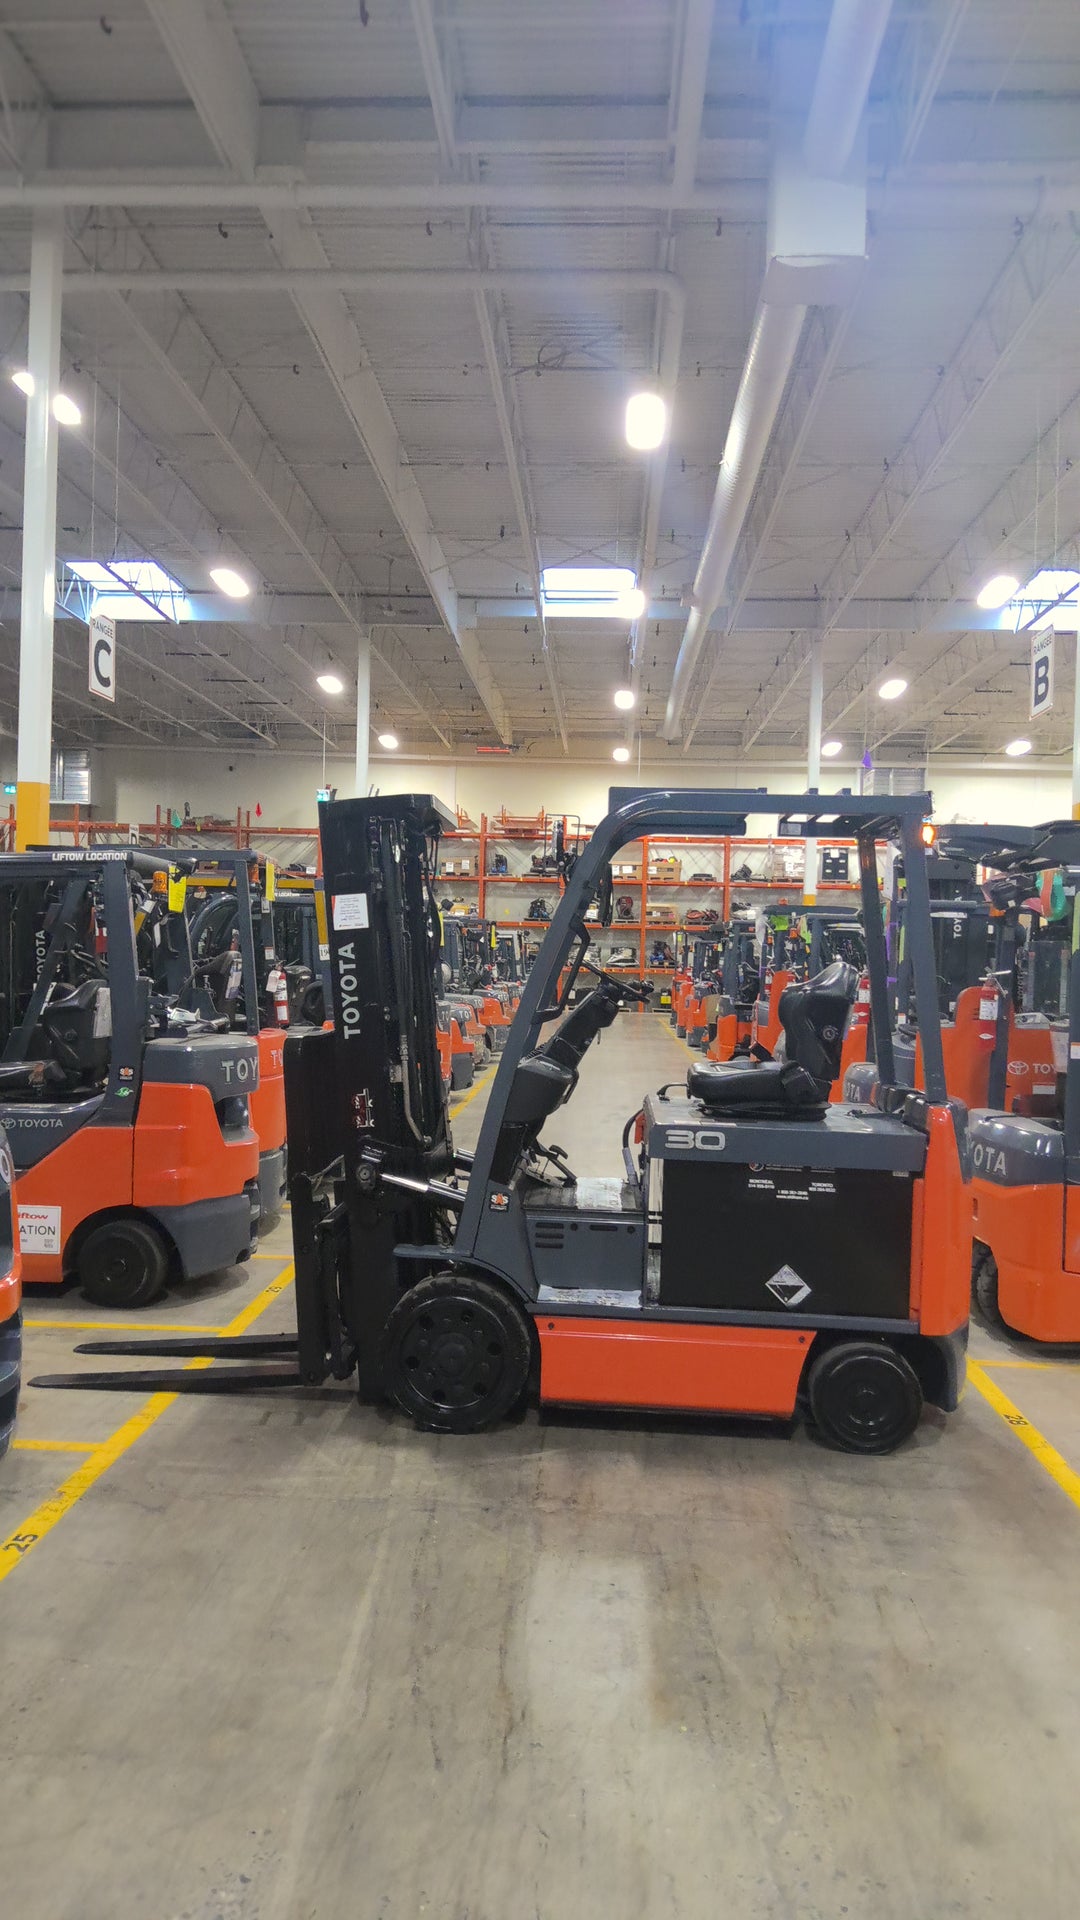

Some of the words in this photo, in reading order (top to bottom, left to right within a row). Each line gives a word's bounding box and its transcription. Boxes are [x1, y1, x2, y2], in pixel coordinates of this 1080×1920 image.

[94, 639, 112, 688] C
[1034, 656, 1049, 708] B
[52, 852, 84, 861] LIFTOW
[85, 852, 127, 861] LOCATION
[338, 942, 361, 1040] TOYOTA
[18, 1118, 64, 1129] TOYOTA
[665, 1129, 726, 1151] 30
[3, 1533, 39, 1553] 25
